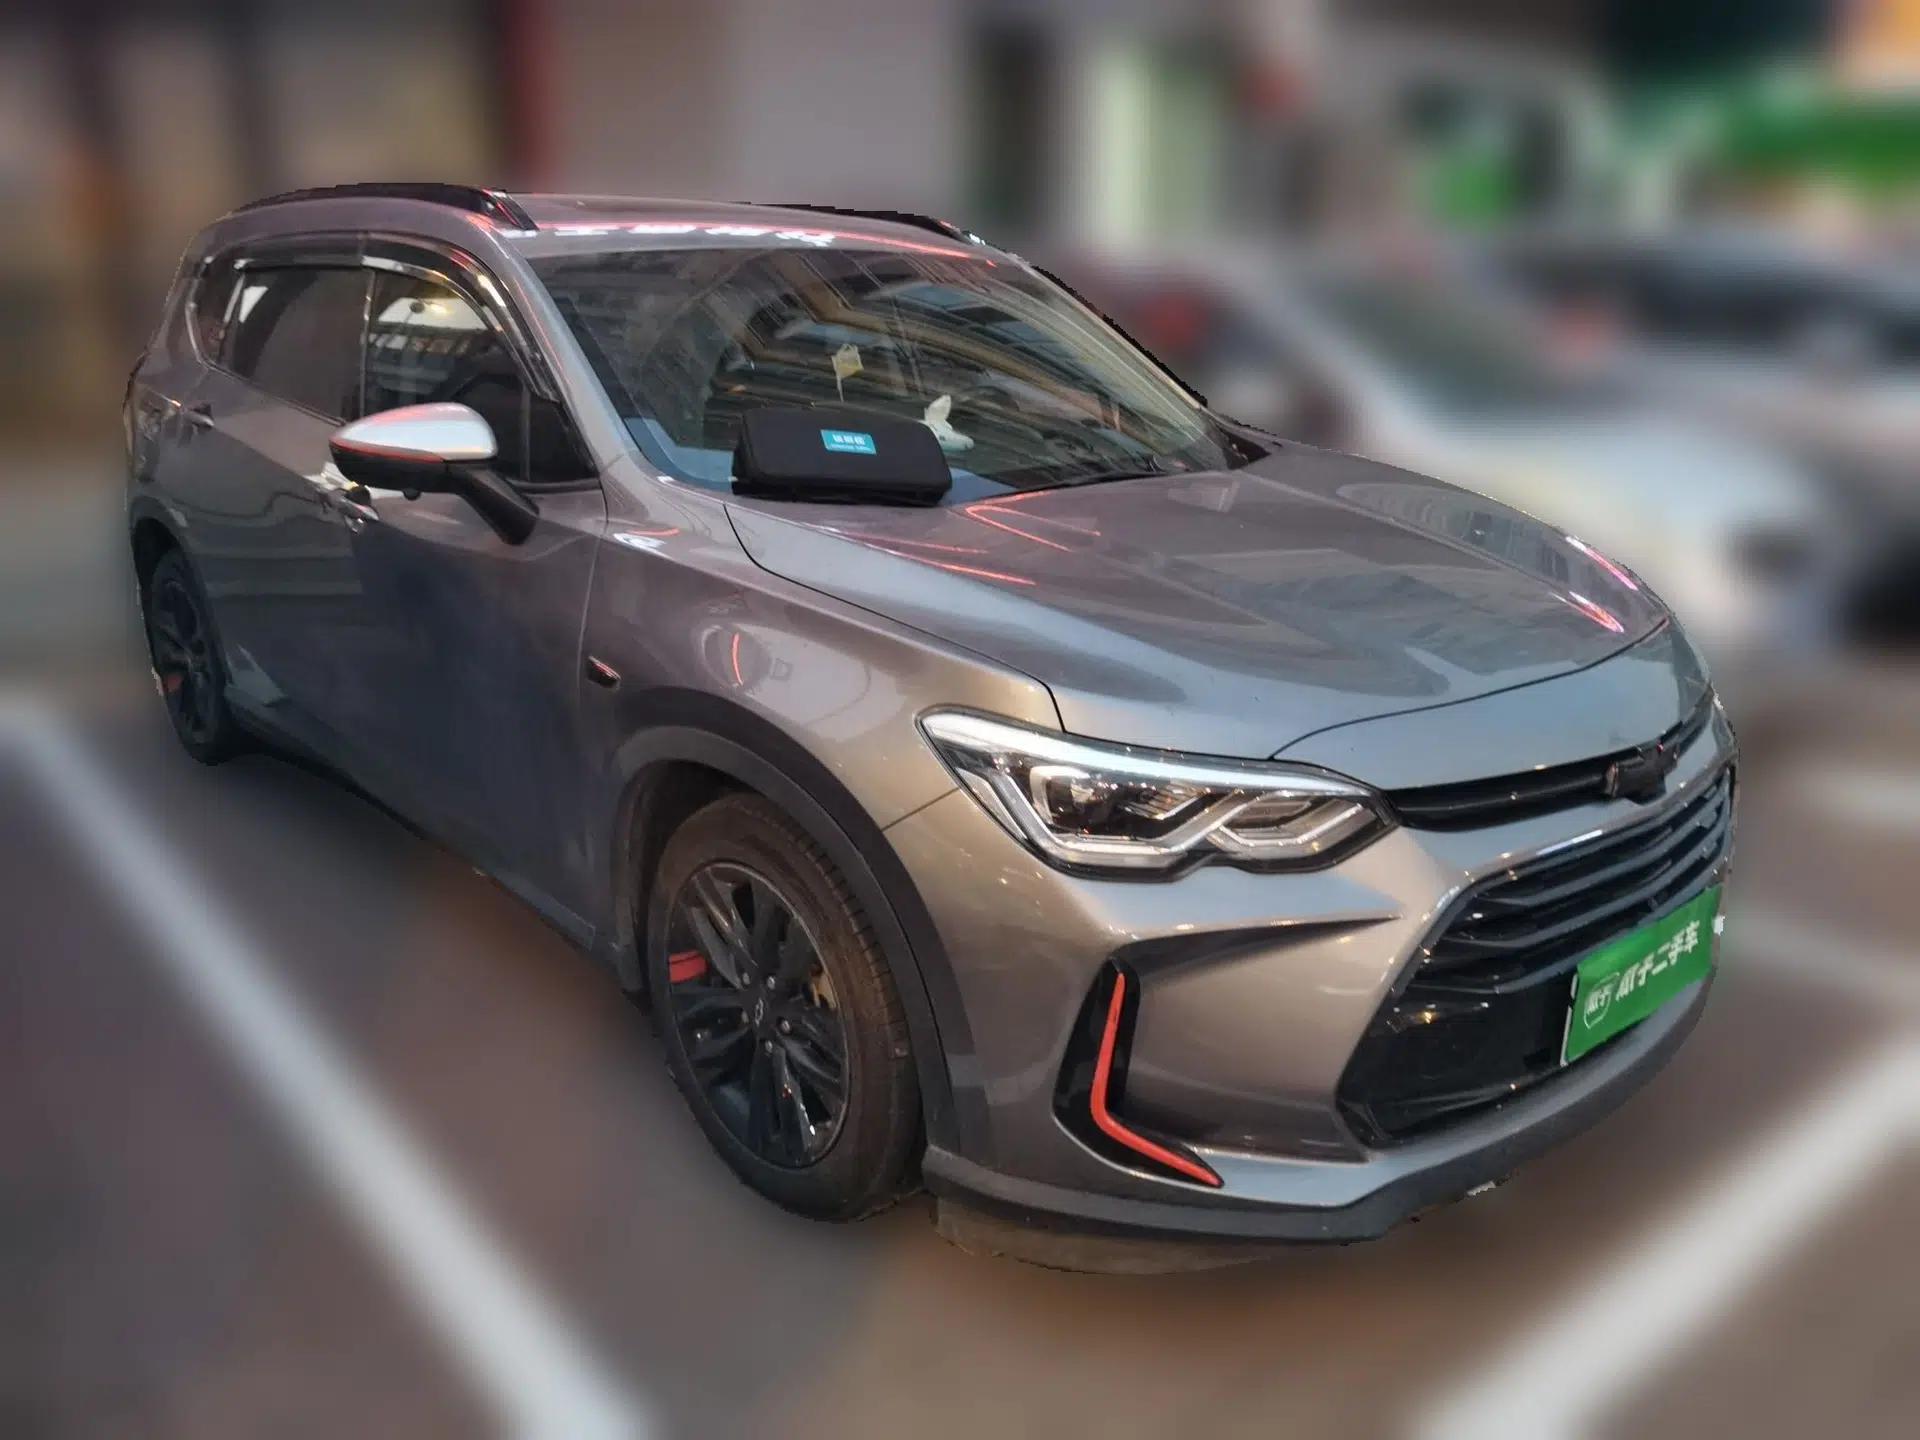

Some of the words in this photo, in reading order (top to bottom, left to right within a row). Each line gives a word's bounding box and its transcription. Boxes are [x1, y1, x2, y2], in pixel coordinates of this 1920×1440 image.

[1615, 920, 1701, 1002] 瓜子二手车
